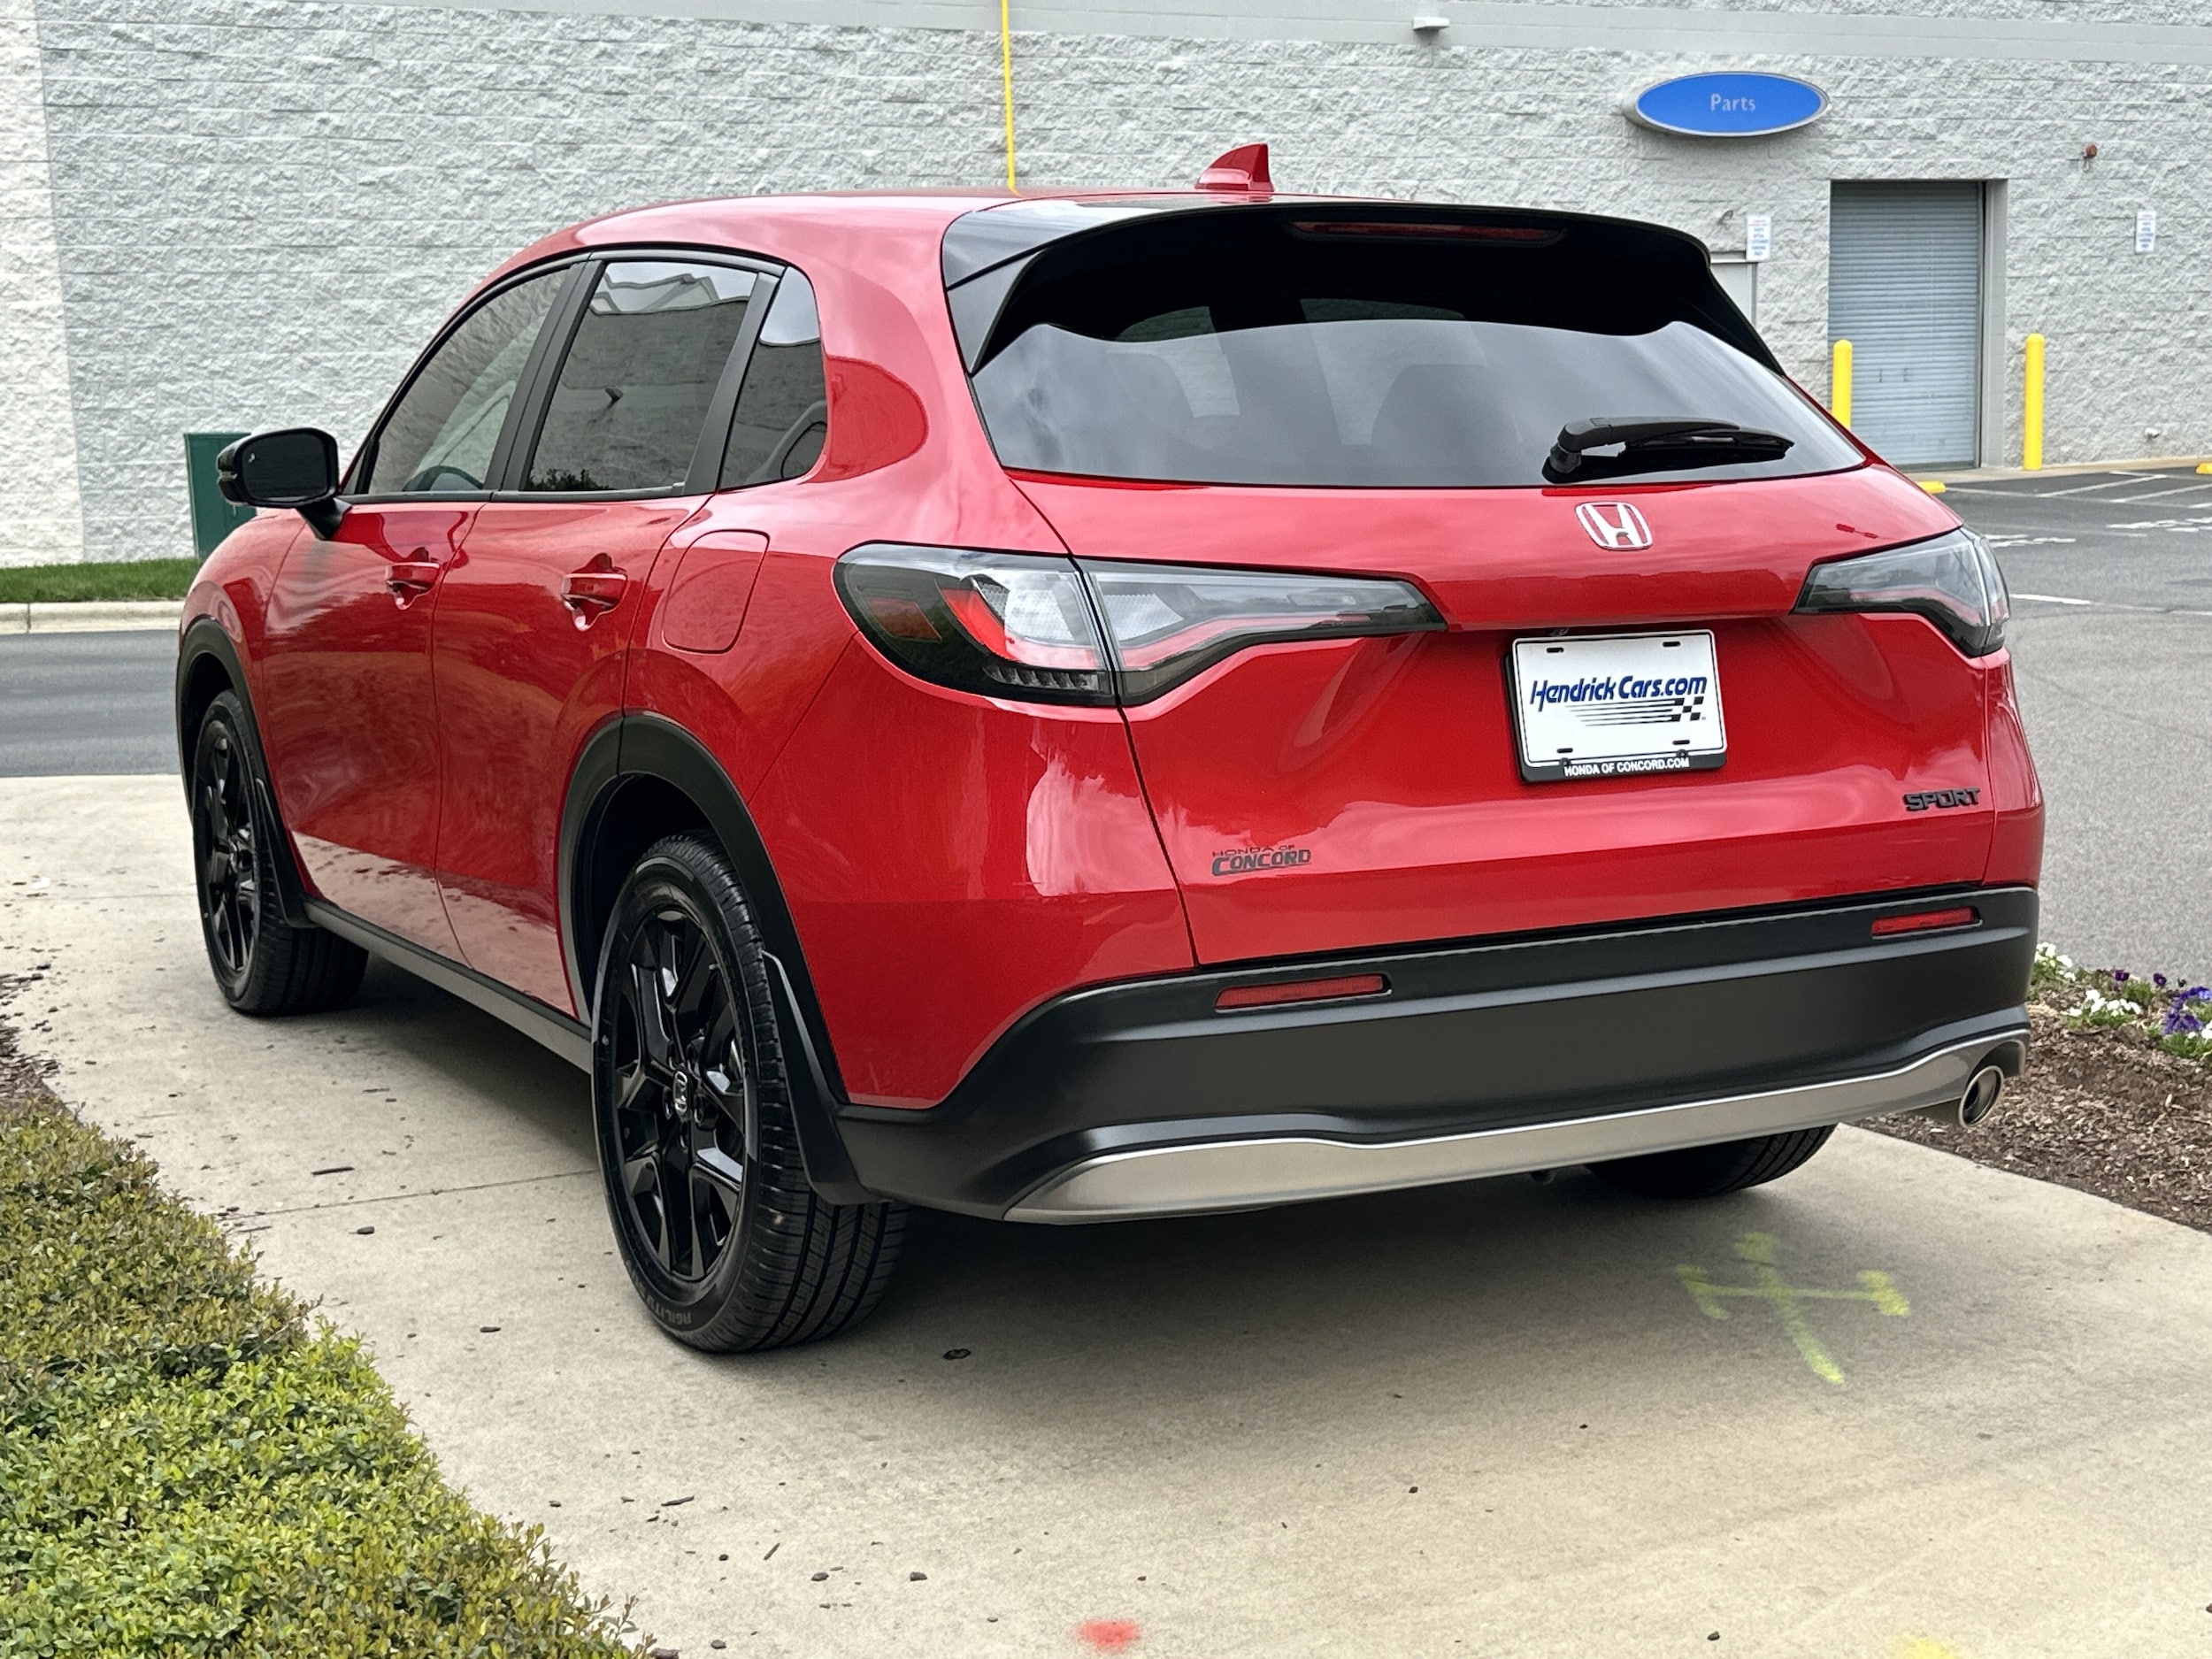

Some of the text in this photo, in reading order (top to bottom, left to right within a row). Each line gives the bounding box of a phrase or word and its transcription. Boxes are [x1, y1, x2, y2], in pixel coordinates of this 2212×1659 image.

[1709, 92, 1756, 112] Parts
[1564, 757, 1690, 777] HONDA OF CONCORD.COM
[1903, 787, 1981, 812] SPORT
[1211, 845, 1274, 857] HONDA
[1211, 849, 1312, 877] CONCORD
